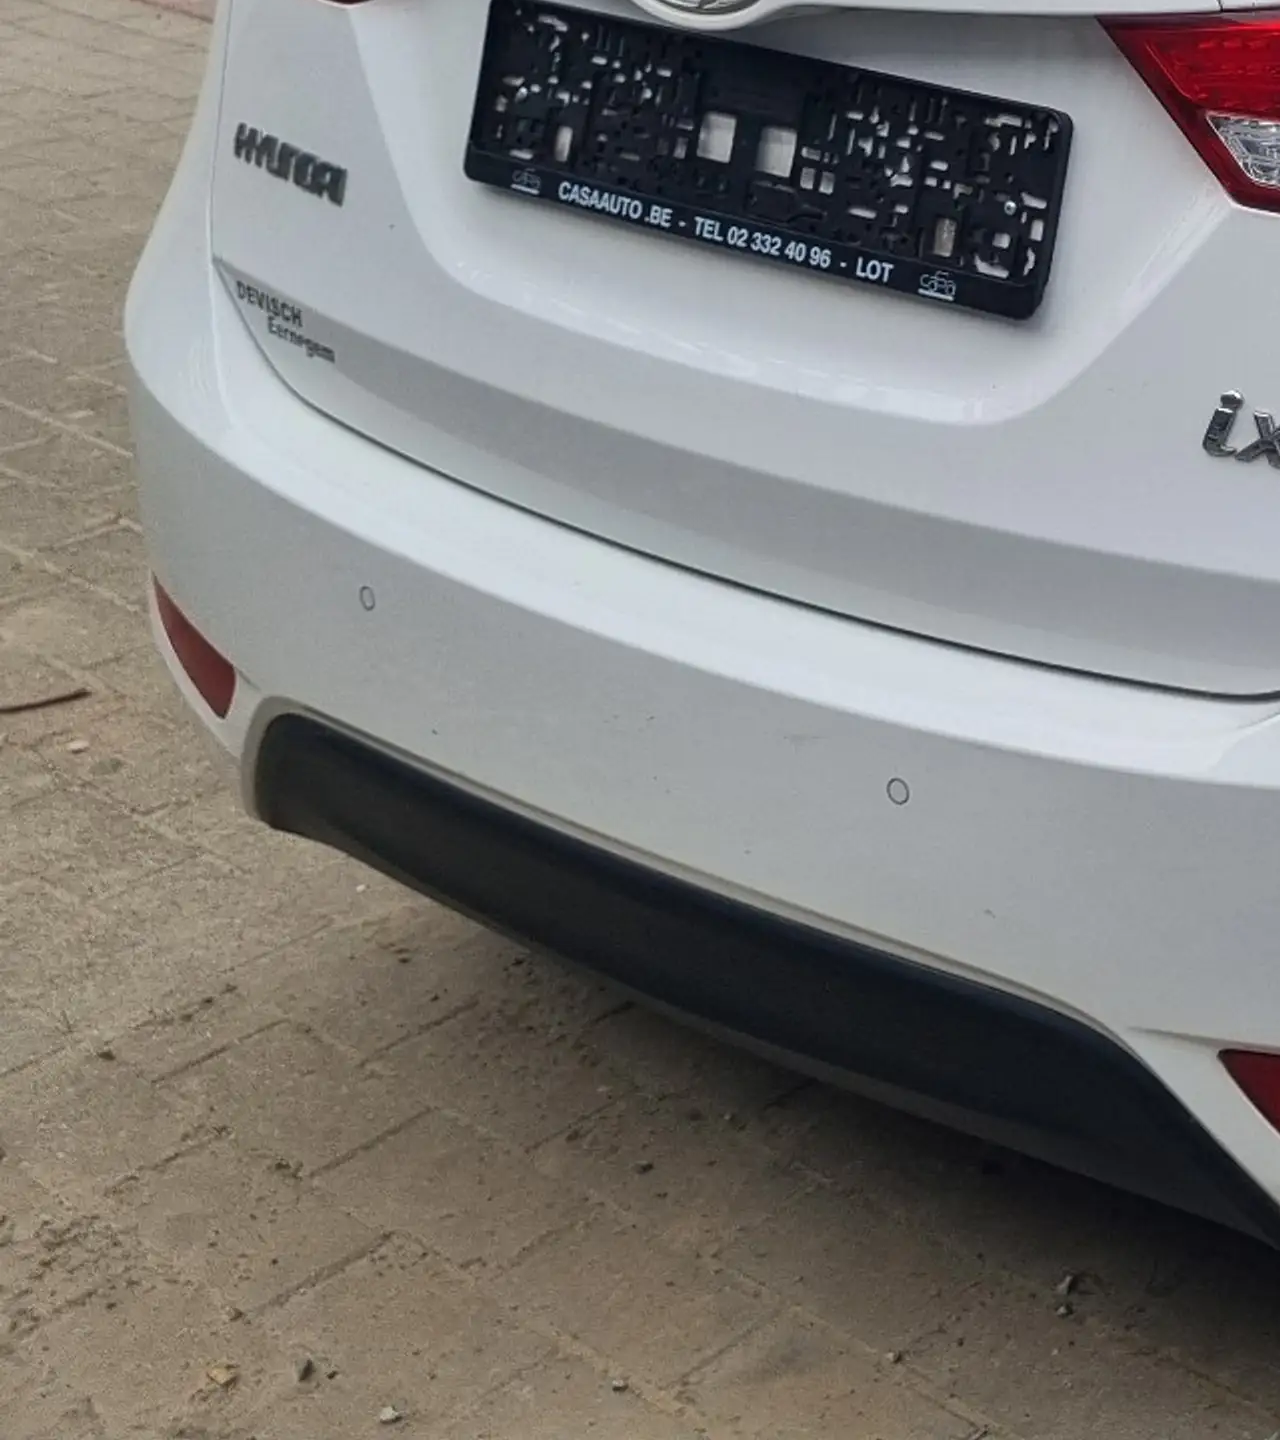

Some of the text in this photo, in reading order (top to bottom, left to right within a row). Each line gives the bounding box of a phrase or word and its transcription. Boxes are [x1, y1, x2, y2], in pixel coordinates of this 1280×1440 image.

[558, 181, 643, 220] CASAAUTO
[694, 216, 724, 242] TEL
[726, 226, 749, 248] 02
[750, 232, 782, 256] 332
[784, 240, 807, 263] 40
[809, 246, 832, 269] 96
[855, 256, 895, 283] LOT
